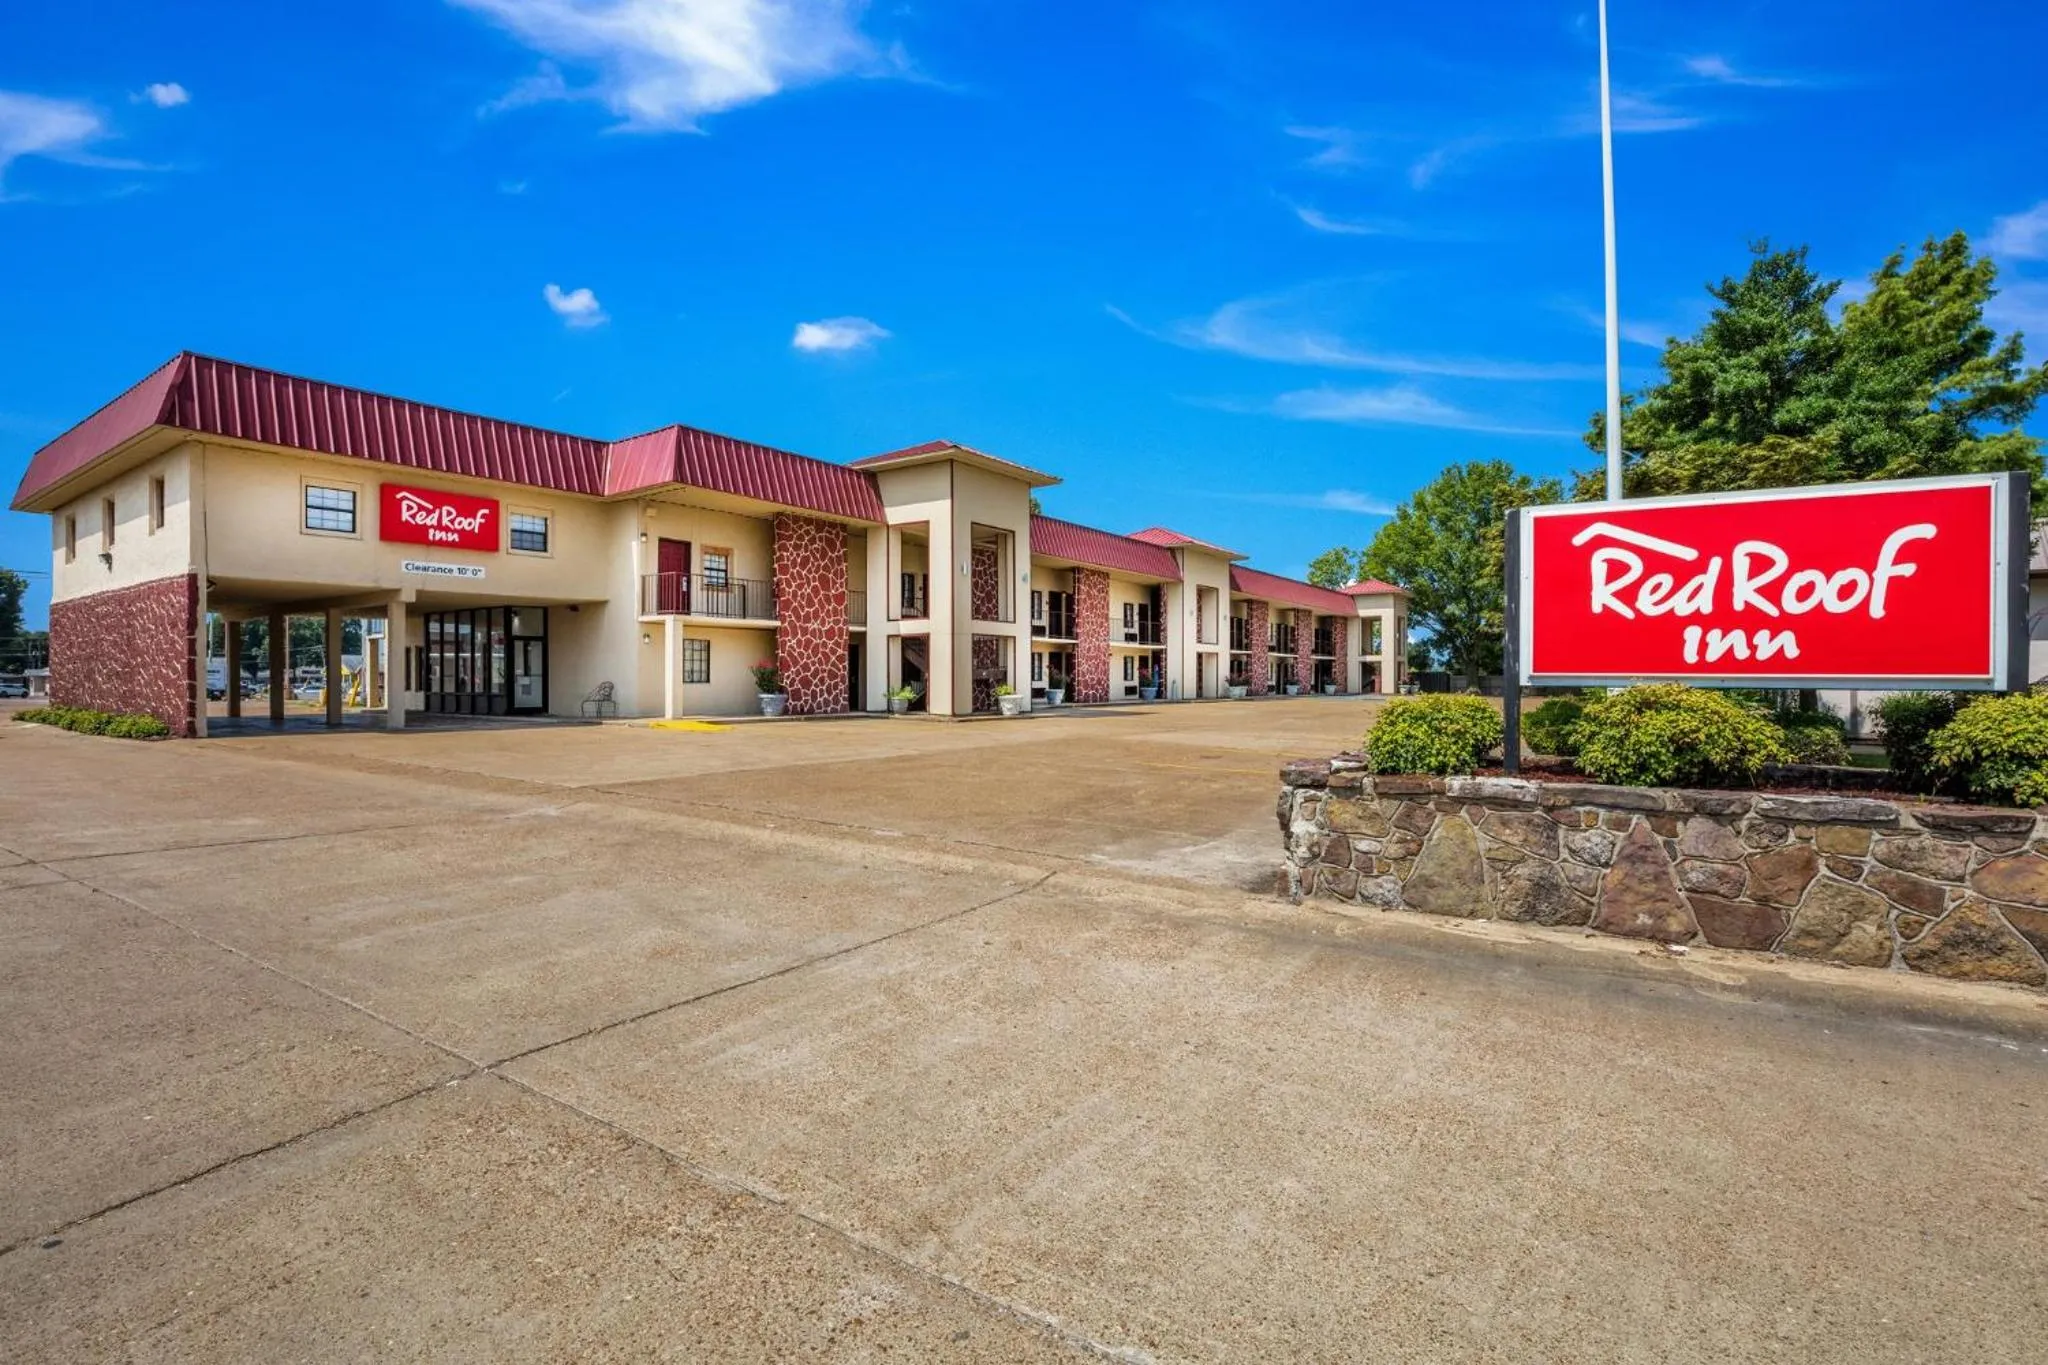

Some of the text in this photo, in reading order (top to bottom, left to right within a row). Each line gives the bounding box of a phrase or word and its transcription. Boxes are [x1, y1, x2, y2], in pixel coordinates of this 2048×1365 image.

[402, 499, 490, 533] Red Roof
[404, 562, 454, 575] Clearance
[1590, 522, 1938, 620] Red Roof
